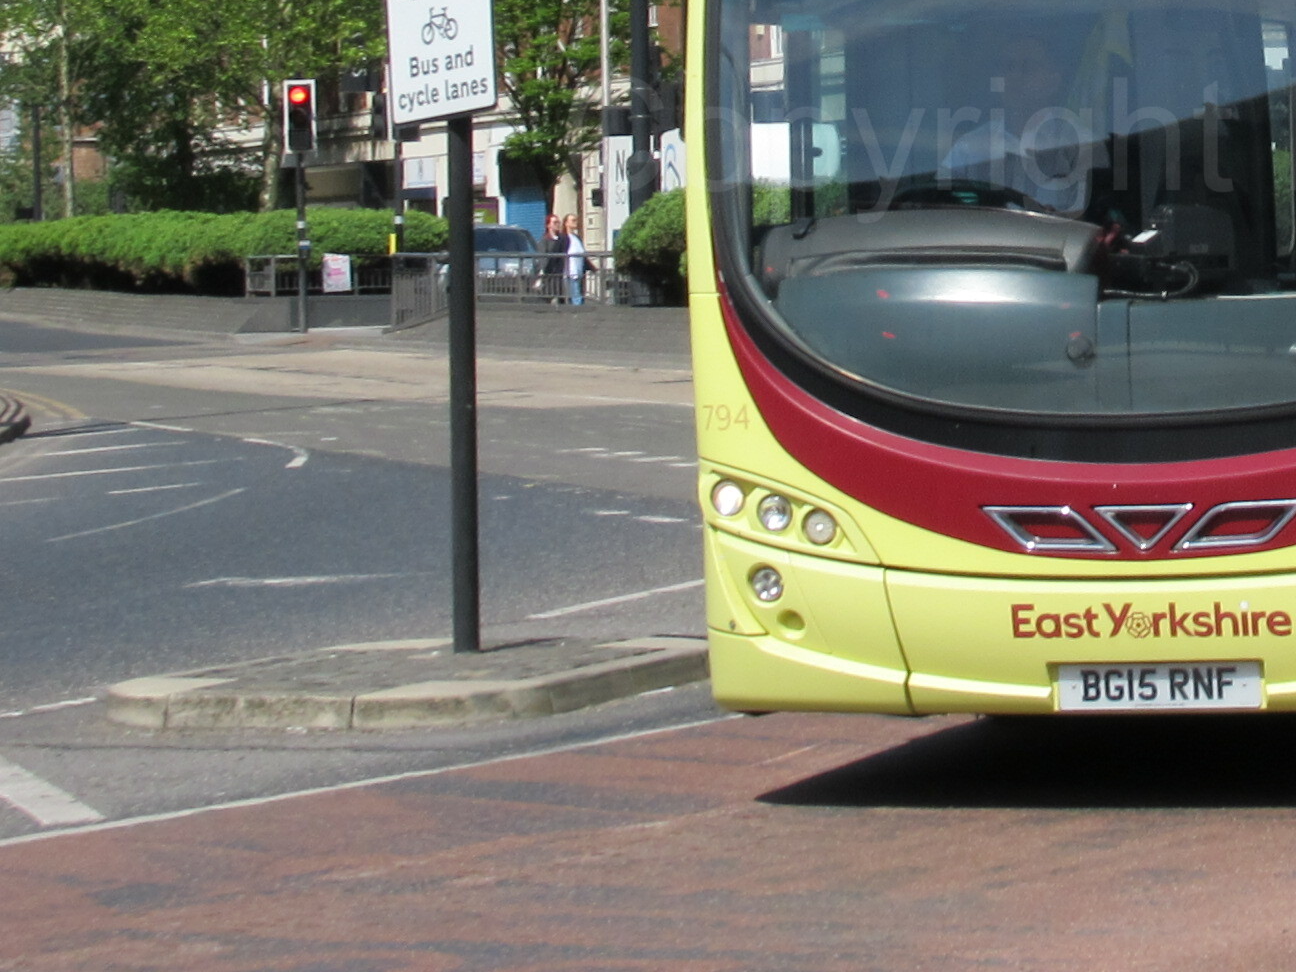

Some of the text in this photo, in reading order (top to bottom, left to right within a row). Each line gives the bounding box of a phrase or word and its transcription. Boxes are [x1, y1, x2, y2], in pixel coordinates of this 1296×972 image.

[409, 44, 474, 78] Bus and
[399, 77, 489, 113] cycle lanes
[702, 404, 750, 431] 794
[1080, 666, 1238, 702] BG15 RNF
